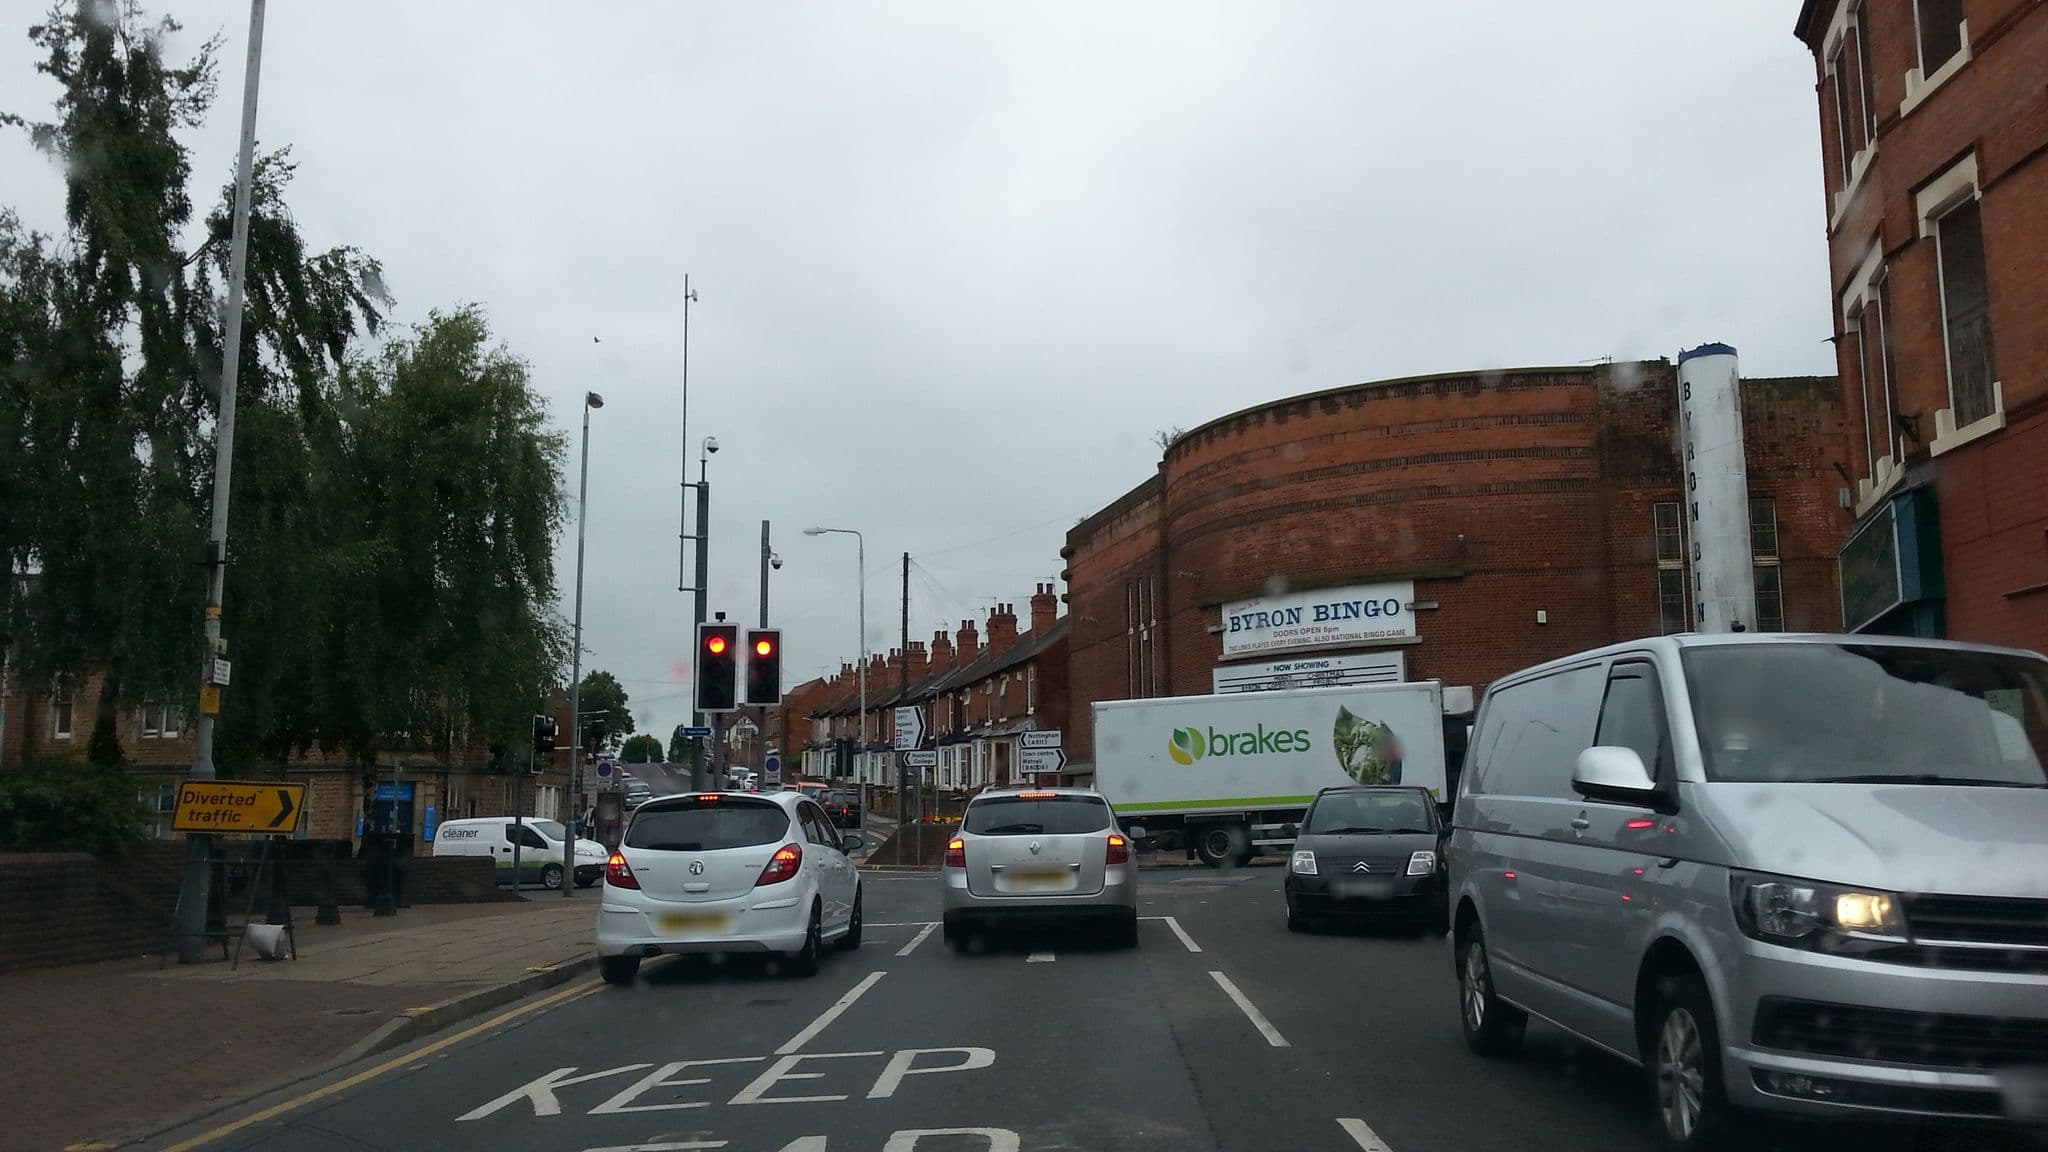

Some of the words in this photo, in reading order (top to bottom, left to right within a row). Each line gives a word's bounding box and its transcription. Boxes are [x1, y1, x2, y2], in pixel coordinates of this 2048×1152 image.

[1683, 381, 1700, 522] BYRON
[1229, 607, 1302, 632] BYRON
[1312, 598, 1400, 622] BINGO
[1252, 641, 1270, 649] PLAYED
[1271, 639, 1286, 647] EVERY
[1332, 631, 1362, 641] NATIONAL
[1363, 630, 1385, 638] BINGO
[1387, 629, 1406, 637] GAME
[1273, 630, 1298, 638] DOORS
[1300, 627, 1321, 635] OPEN
[1273, 663, 1292, 673] NOW
[1294, 660, 1330, 671] SHOWING
[1207, 723, 1311, 757] brakes
[183, 791, 257, 806] Diverted
[188, 809, 242, 823] traffic
[442, 828, 479, 839] cleaner
[455, 1046, 996, 1122] KEEP
